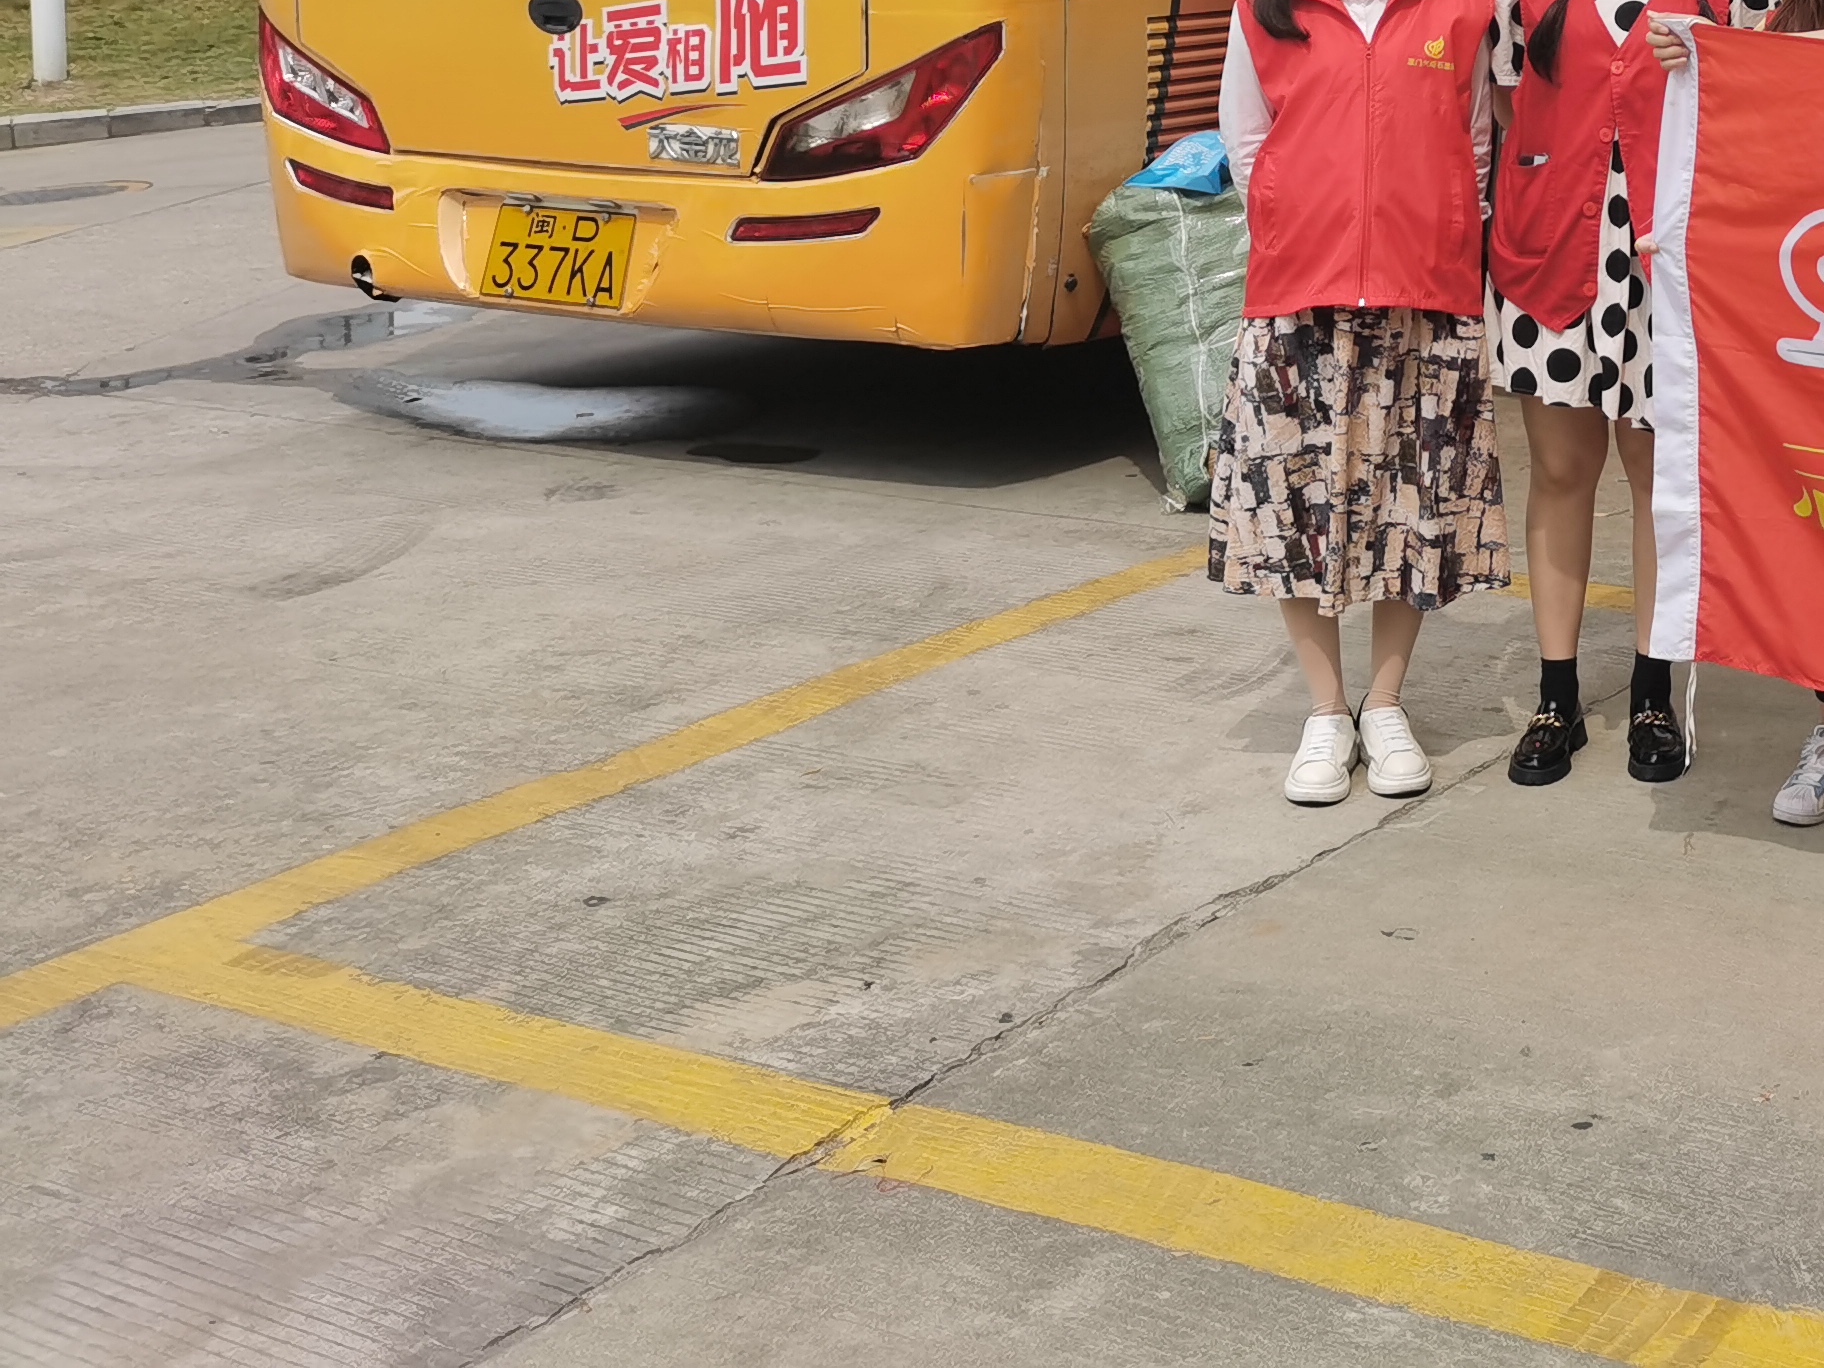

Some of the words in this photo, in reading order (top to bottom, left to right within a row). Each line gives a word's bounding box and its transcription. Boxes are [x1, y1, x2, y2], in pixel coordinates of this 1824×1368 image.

[648, 123, 740, 168] 大金龙
[491, 240, 616, 301] 337KA
